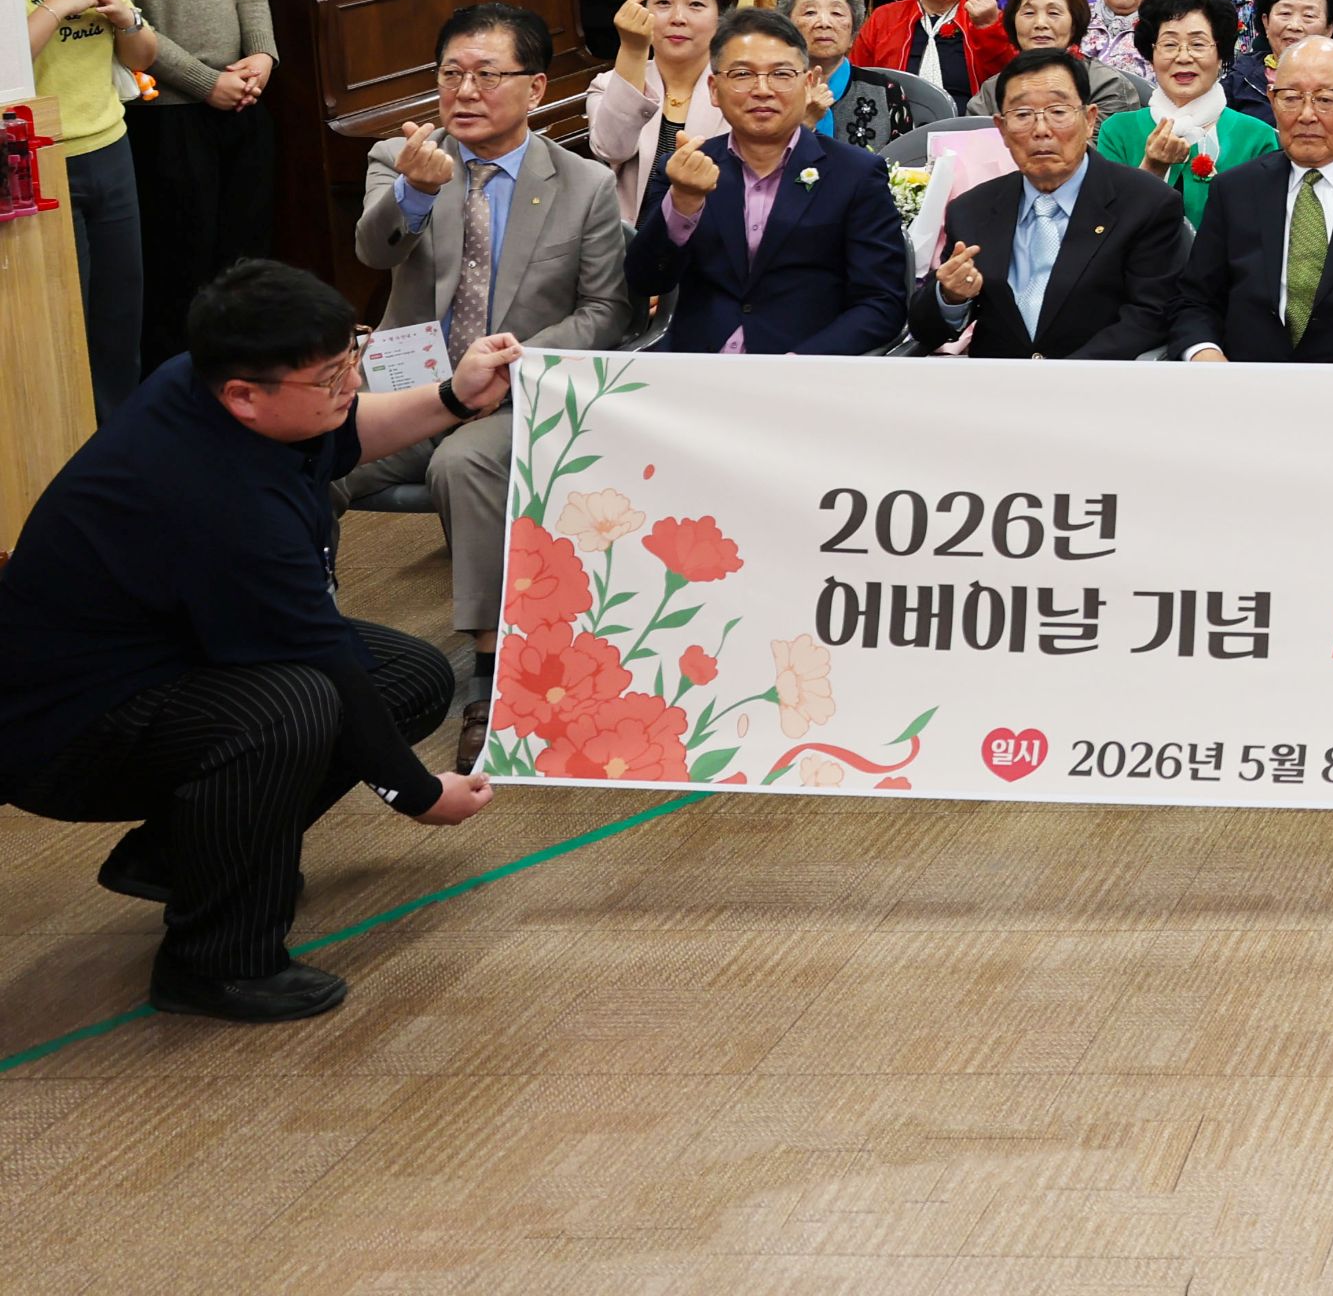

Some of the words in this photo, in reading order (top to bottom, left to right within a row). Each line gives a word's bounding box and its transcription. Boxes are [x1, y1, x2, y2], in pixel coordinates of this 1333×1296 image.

[59, 22, 104, 42] Paris
[819, 487, 1118, 561] 2026년
[815, 574, 1107, 655] 어버이날
[1130, 589, 1271, 660] 기념
[990, 738, 1041, 767] 일시
[1067, 740, 1224, 782] 2026년
[1238, 743, 1307, 784] 5월
